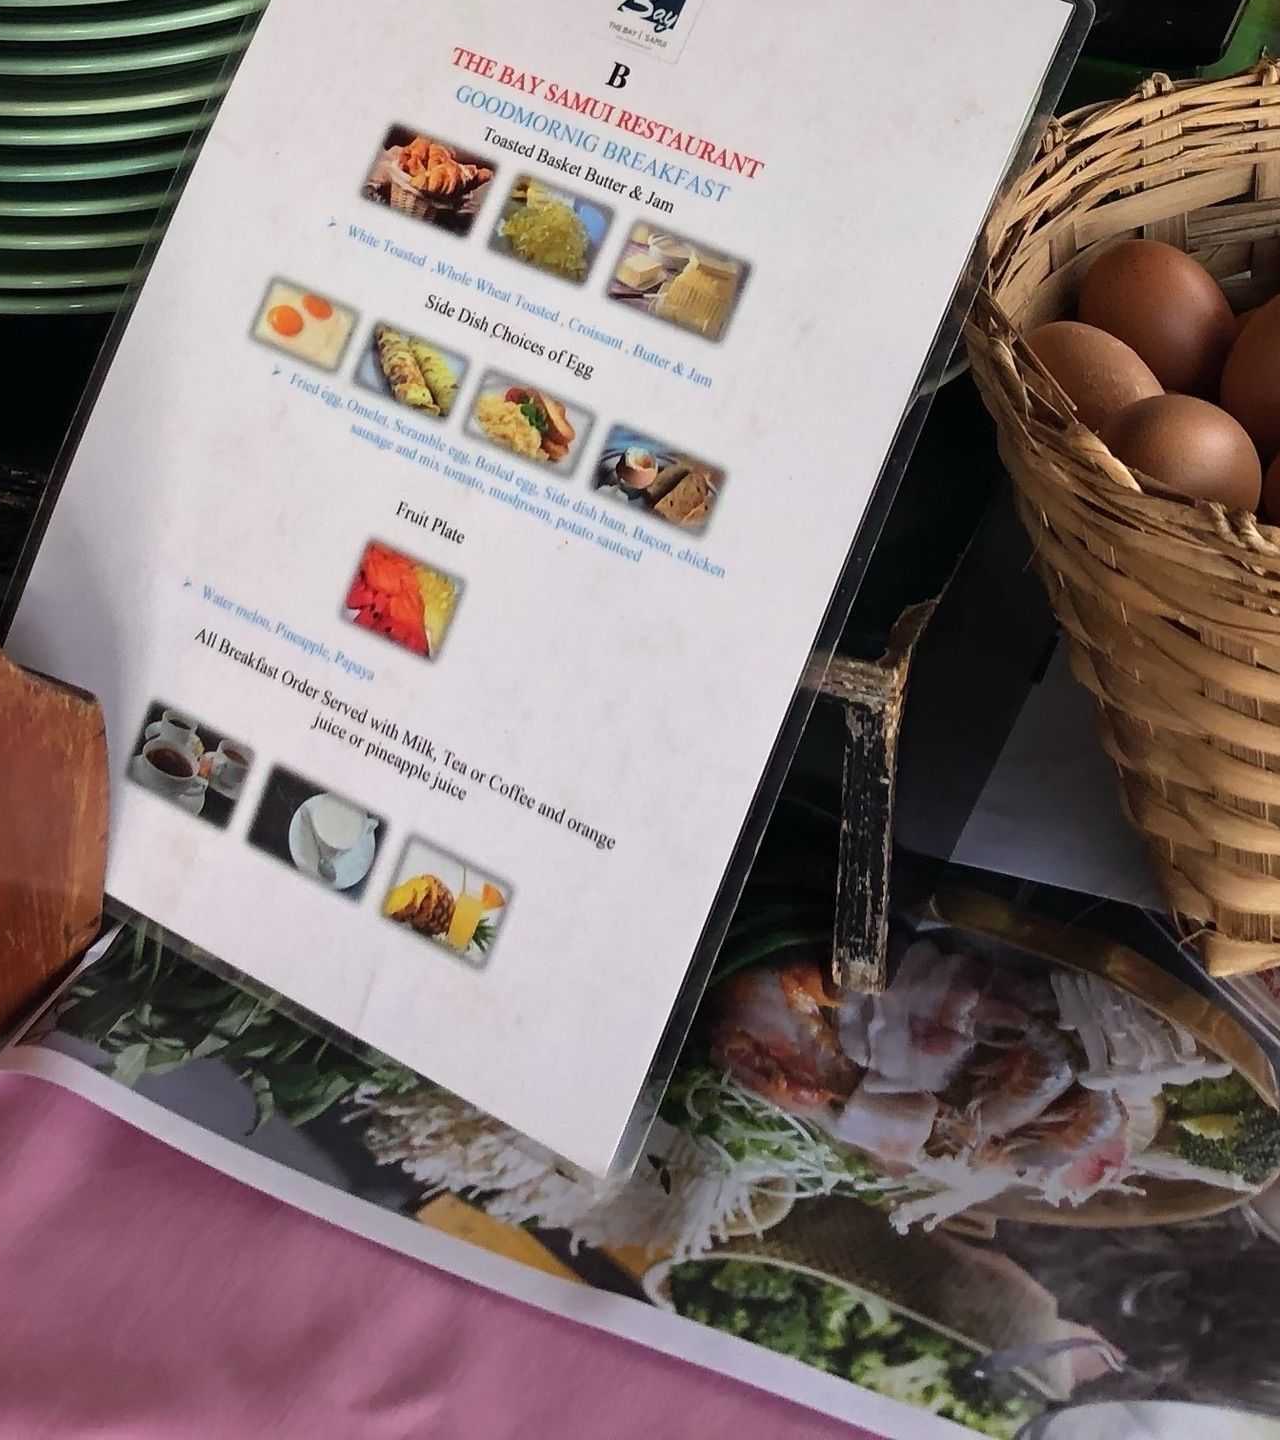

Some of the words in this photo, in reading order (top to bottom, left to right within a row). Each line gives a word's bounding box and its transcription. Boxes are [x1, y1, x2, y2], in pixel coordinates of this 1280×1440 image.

[606, 61, 631, 90] B
[608, 21, 622, 32] THE
[622, 25, 637, 37] BAY
[644, 34, 669, 49] SAMUI
[452, 46, 498, 79] THE
[497, 64, 546, 95] BAY
[543, 83, 617, 123] SAMUI
[614, 109, 765, 179] RESTAURANT
[455, 85, 600, 153] GOODMORNIG
[602, 140, 731, 202] BREAKFAST
[484, 126, 536, 158] Toasted
[535, 147, 582, 177] Basket
[583, 166, 628, 195] Butter
[628, 185, 643, 201] &
[644, 191, 674, 214] Jam
[348, 224, 381, 248] White
[383, 239, 428, 268] Toasted
[474, 277, 512, 304] Wheat
[515, 294, 561, 323] Toasted
[568, 317, 624, 350] Croissant
[632, 343, 671, 370] Butter
[671, 361, 685, 377] &
[686, 367, 713, 389] Jam
[424, 294, 456, 318] Side
[457, 307, 489, 333] Dish
[547, 349, 568, 364] of
[565, 353, 594, 381] Egg
[289, 372, 321, 396] Fried
[392, 418, 447, 452] Scramble
[474, 454, 515, 483] Boiled
[542, 485, 571, 508] Side
[571, 499, 598, 521] dish
[599, 510, 628, 537] ham,
[676, 548, 726, 579] chicken
[349, 423, 394, 450] sausage
[394, 444, 419, 461] and
[417, 454, 440, 472] mix
[442, 464, 485, 494] tomato,
[488, 486, 553, 525] mushroom,
[554, 516, 594, 541] potato
[395, 500, 429, 528] Fruit
[430, 517, 465, 544] Plate
[202, 584, 235, 612] Water
[234, 605, 272, 633] melon,
[274, 621, 331, 662] Pineapple,
[334, 649, 375, 681] Papaya
[194, 627, 218, 648] All
[218, 637, 279, 680] Breakfast
[281, 670, 320, 699] Order
[320, 689, 369, 724] Served
[370, 716, 399, 741] with
[401, 729, 437, 763] Milk,
[443, 749, 468, 776] Tea
[470, 768, 487, 784] or
[488, 774, 536, 810] Coffee
[537, 802, 566, 825] and
[567, 817, 616, 850] orange
[310, 711, 347, 740] juice
[348, 733, 365, 748] or
[364, 741, 431, 783] pineapple
[428, 771, 467, 801] juice
